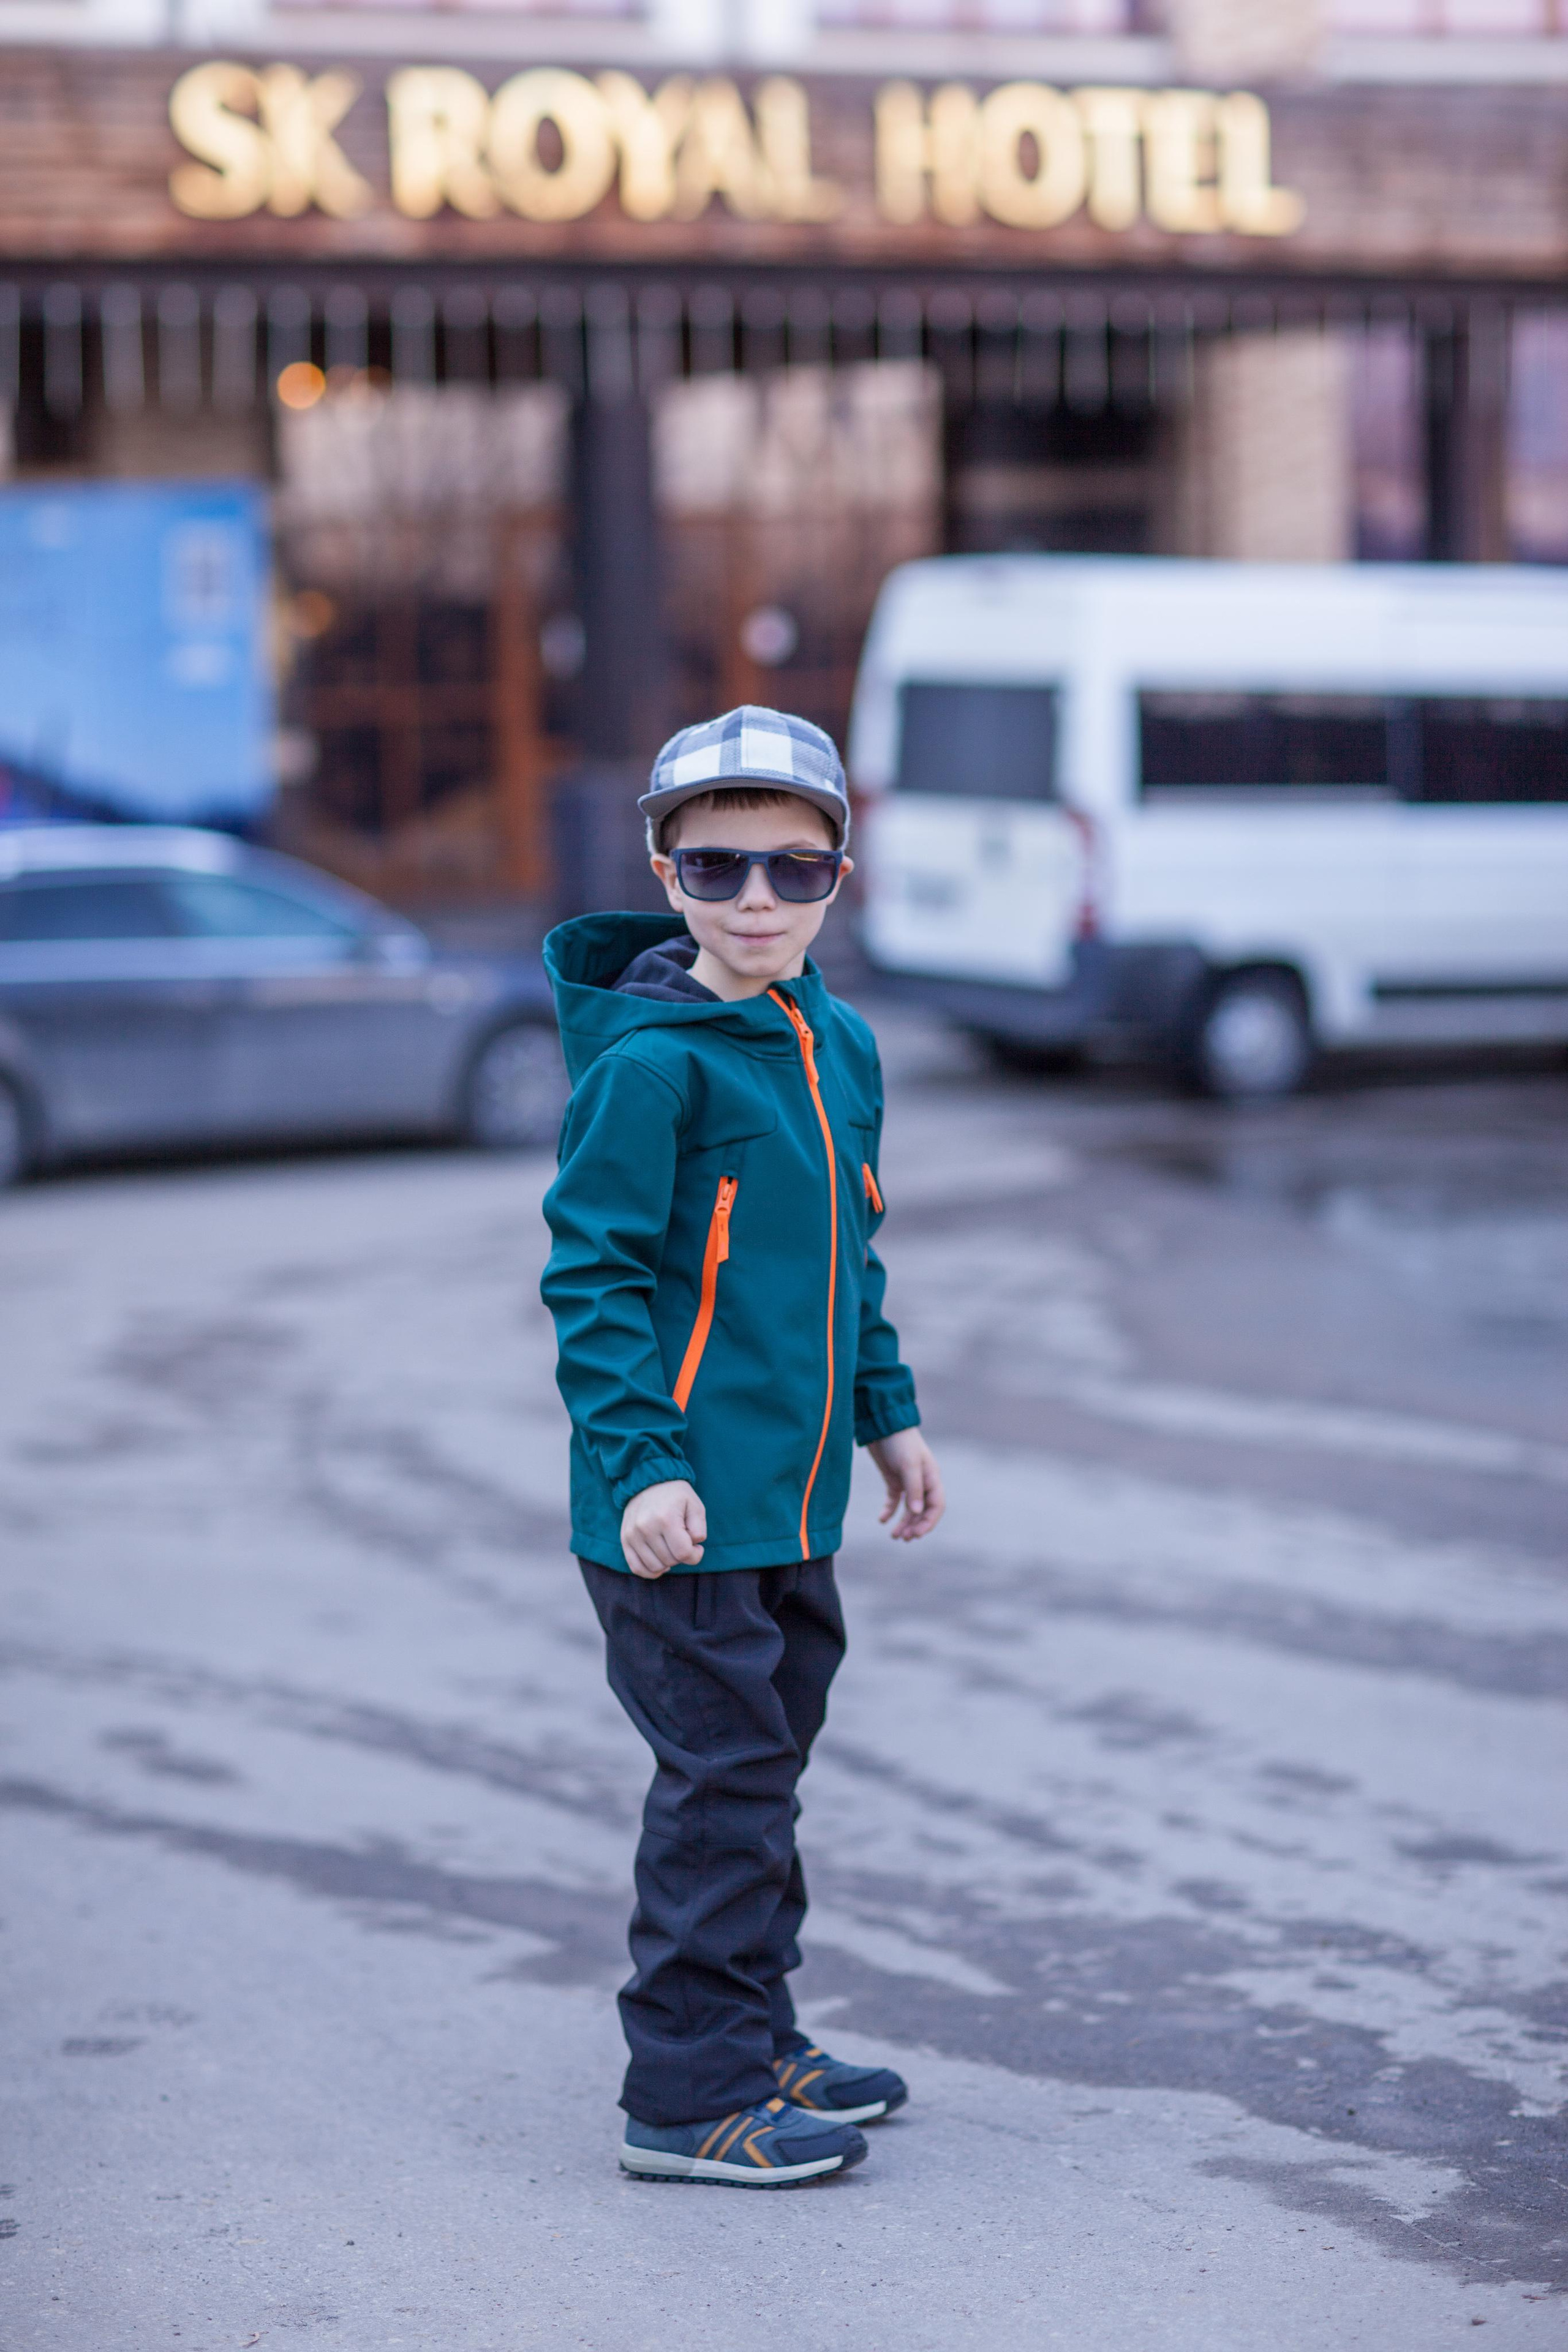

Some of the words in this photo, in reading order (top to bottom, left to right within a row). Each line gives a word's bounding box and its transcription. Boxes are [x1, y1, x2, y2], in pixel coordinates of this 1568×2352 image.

[168, 61, 369, 221] SK
[386, 66, 844, 222] ROYAL
[874, 80, 1305, 238] HOTEL
